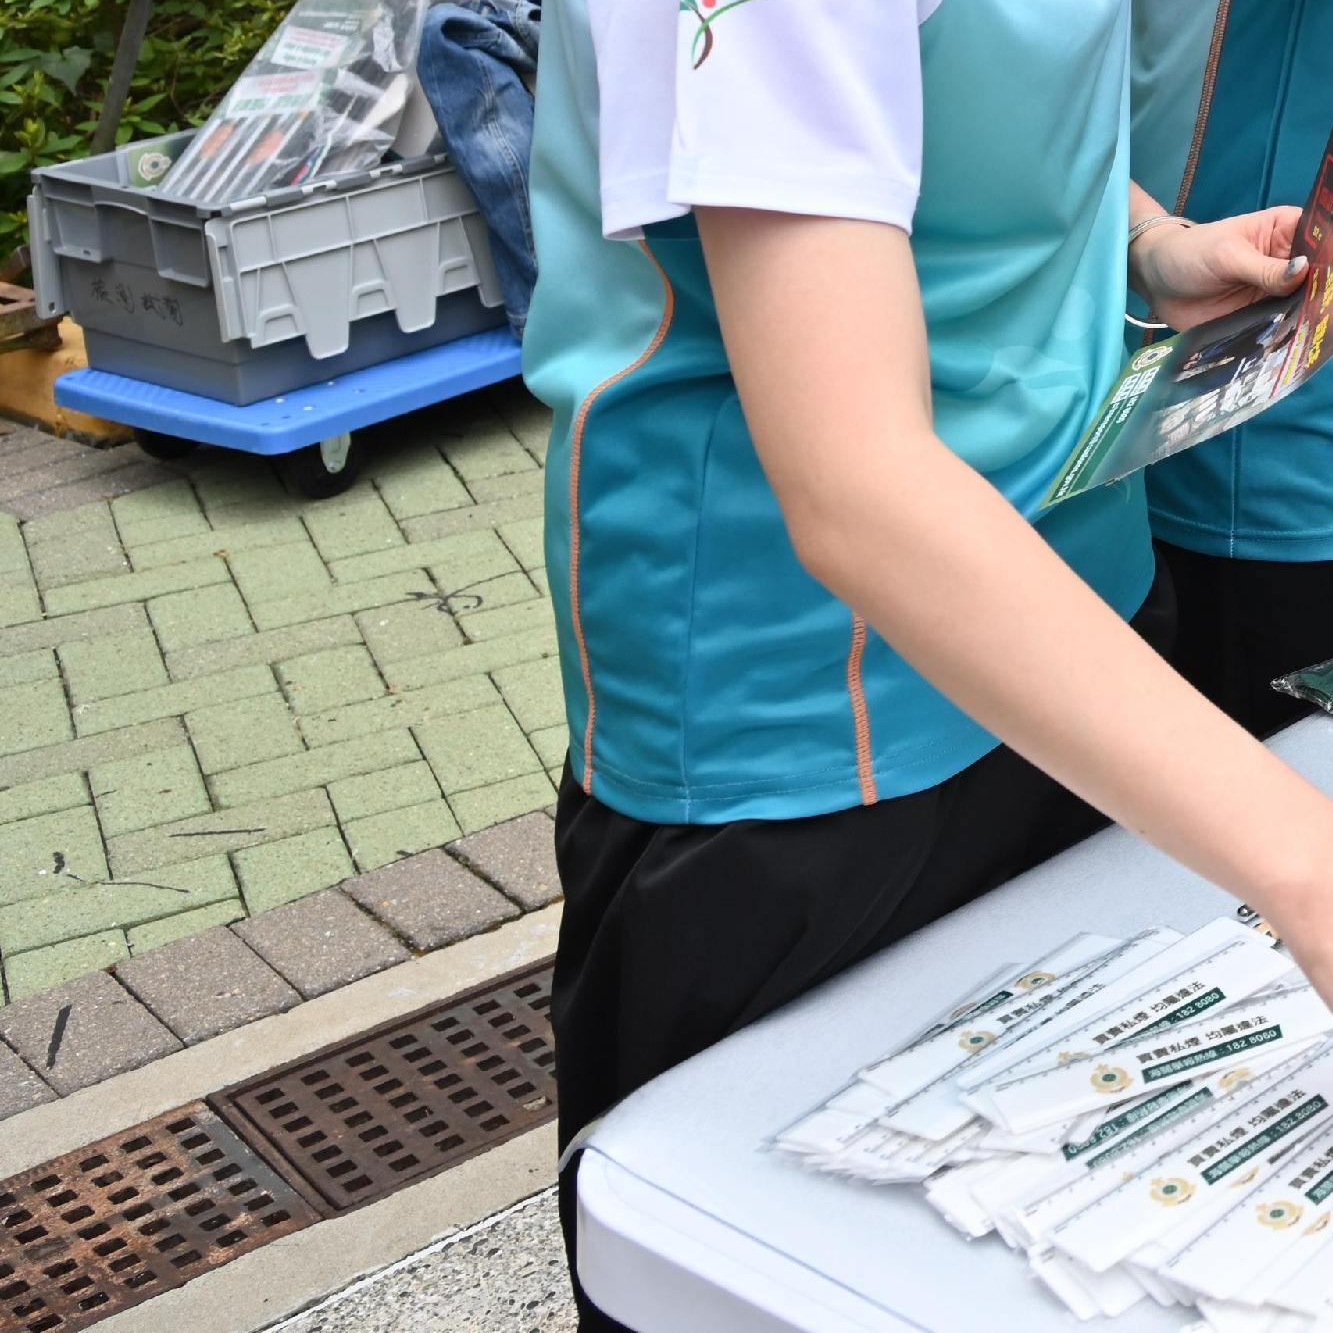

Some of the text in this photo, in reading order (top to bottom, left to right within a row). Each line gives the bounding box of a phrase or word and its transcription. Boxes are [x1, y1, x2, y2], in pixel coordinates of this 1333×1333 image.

[1092, 1010, 1148, 1045] 買賣私煙
[1150, 981, 1205, 1013] 均屬違法
[1176, 992, 1220, 1018] 182 8080
[1136, 1016, 1268, 1064] 買賣私煙 均屬違法
[1226, 1040, 1248, 1052] 182
[1249, 1030, 1277, 1044] 8080
[1188, 1127, 1248, 1166] 買賣私煙
[1248, 1089, 1306, 1128] 均屬違法
[1277, 1117, 1296, 1132] 182
[1296, 1100, 1322, 1118] 8080
